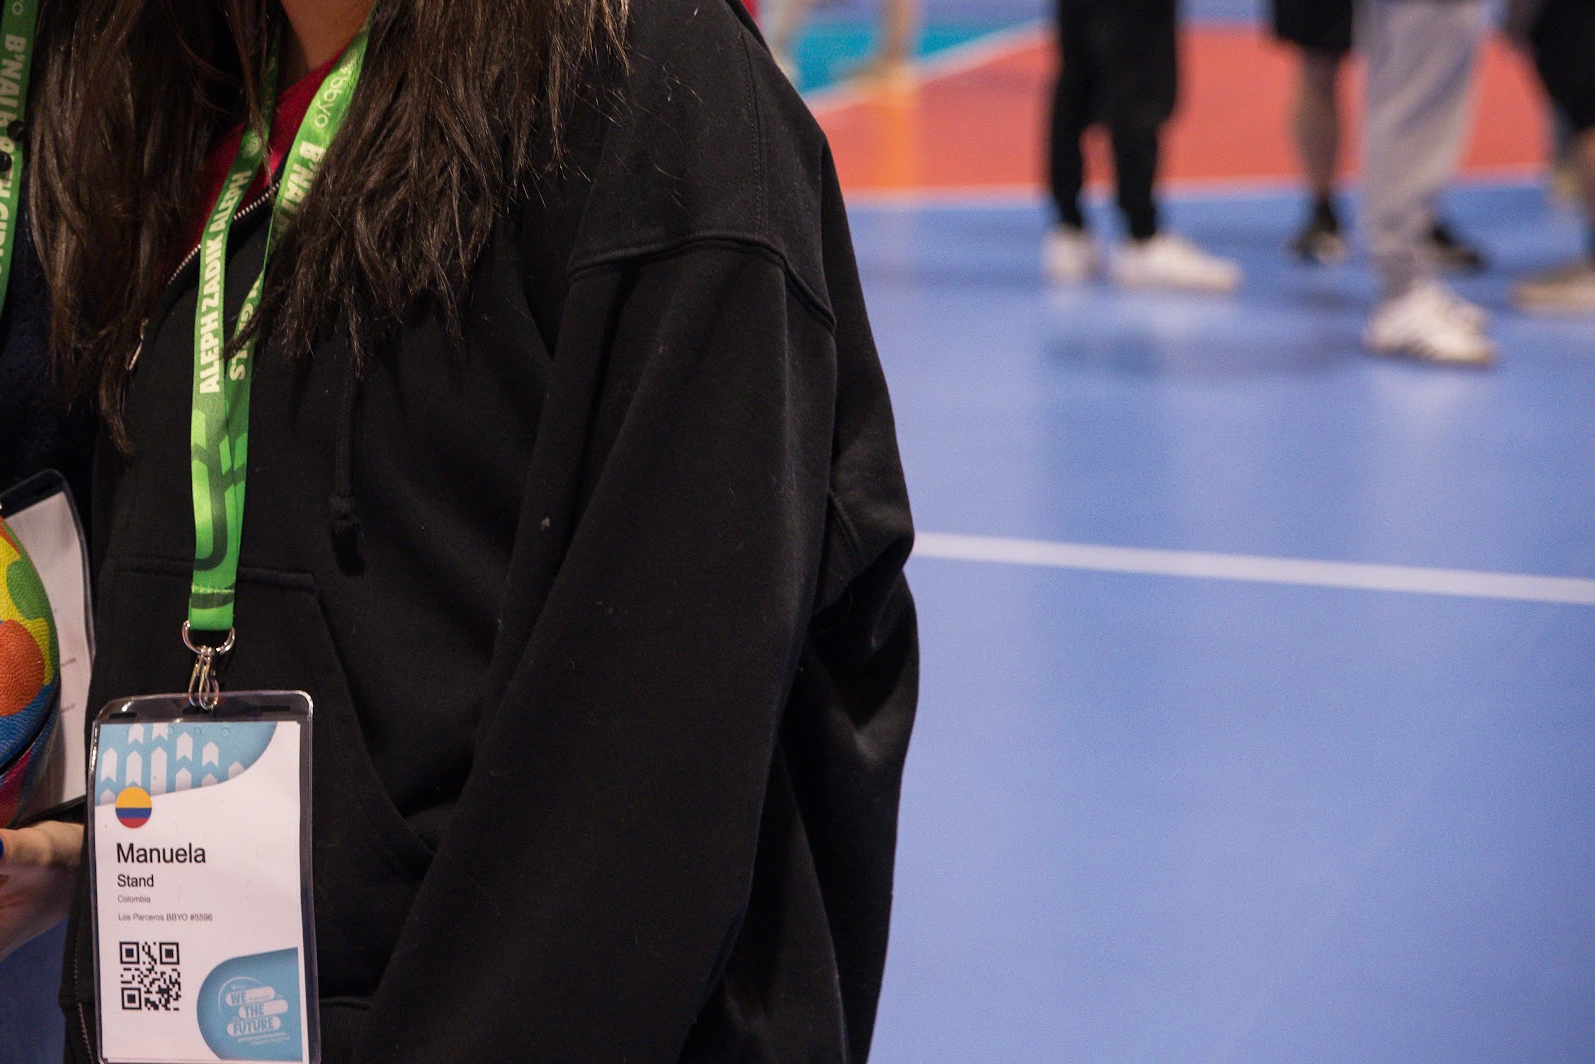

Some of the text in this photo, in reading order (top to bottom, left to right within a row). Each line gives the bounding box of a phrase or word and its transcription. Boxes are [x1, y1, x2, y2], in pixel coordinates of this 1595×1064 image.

[200, 169, 253, 394] ALEPH ZADIK ALEPH
[116, 842, 206, 864] Manuela
[117, 873, 155, 888] Stand
[117, 894, 151, 903] Colombia
[118, 913, 131, 921] Los
[133, 912, 165, 922] Parceros
[166, 913, 188, 922] BBYO
[230, 991, 246, 1005] WE
[245, 1002, 264, 1018] THE
[233, 1017, 274, 1035] FUTURE
